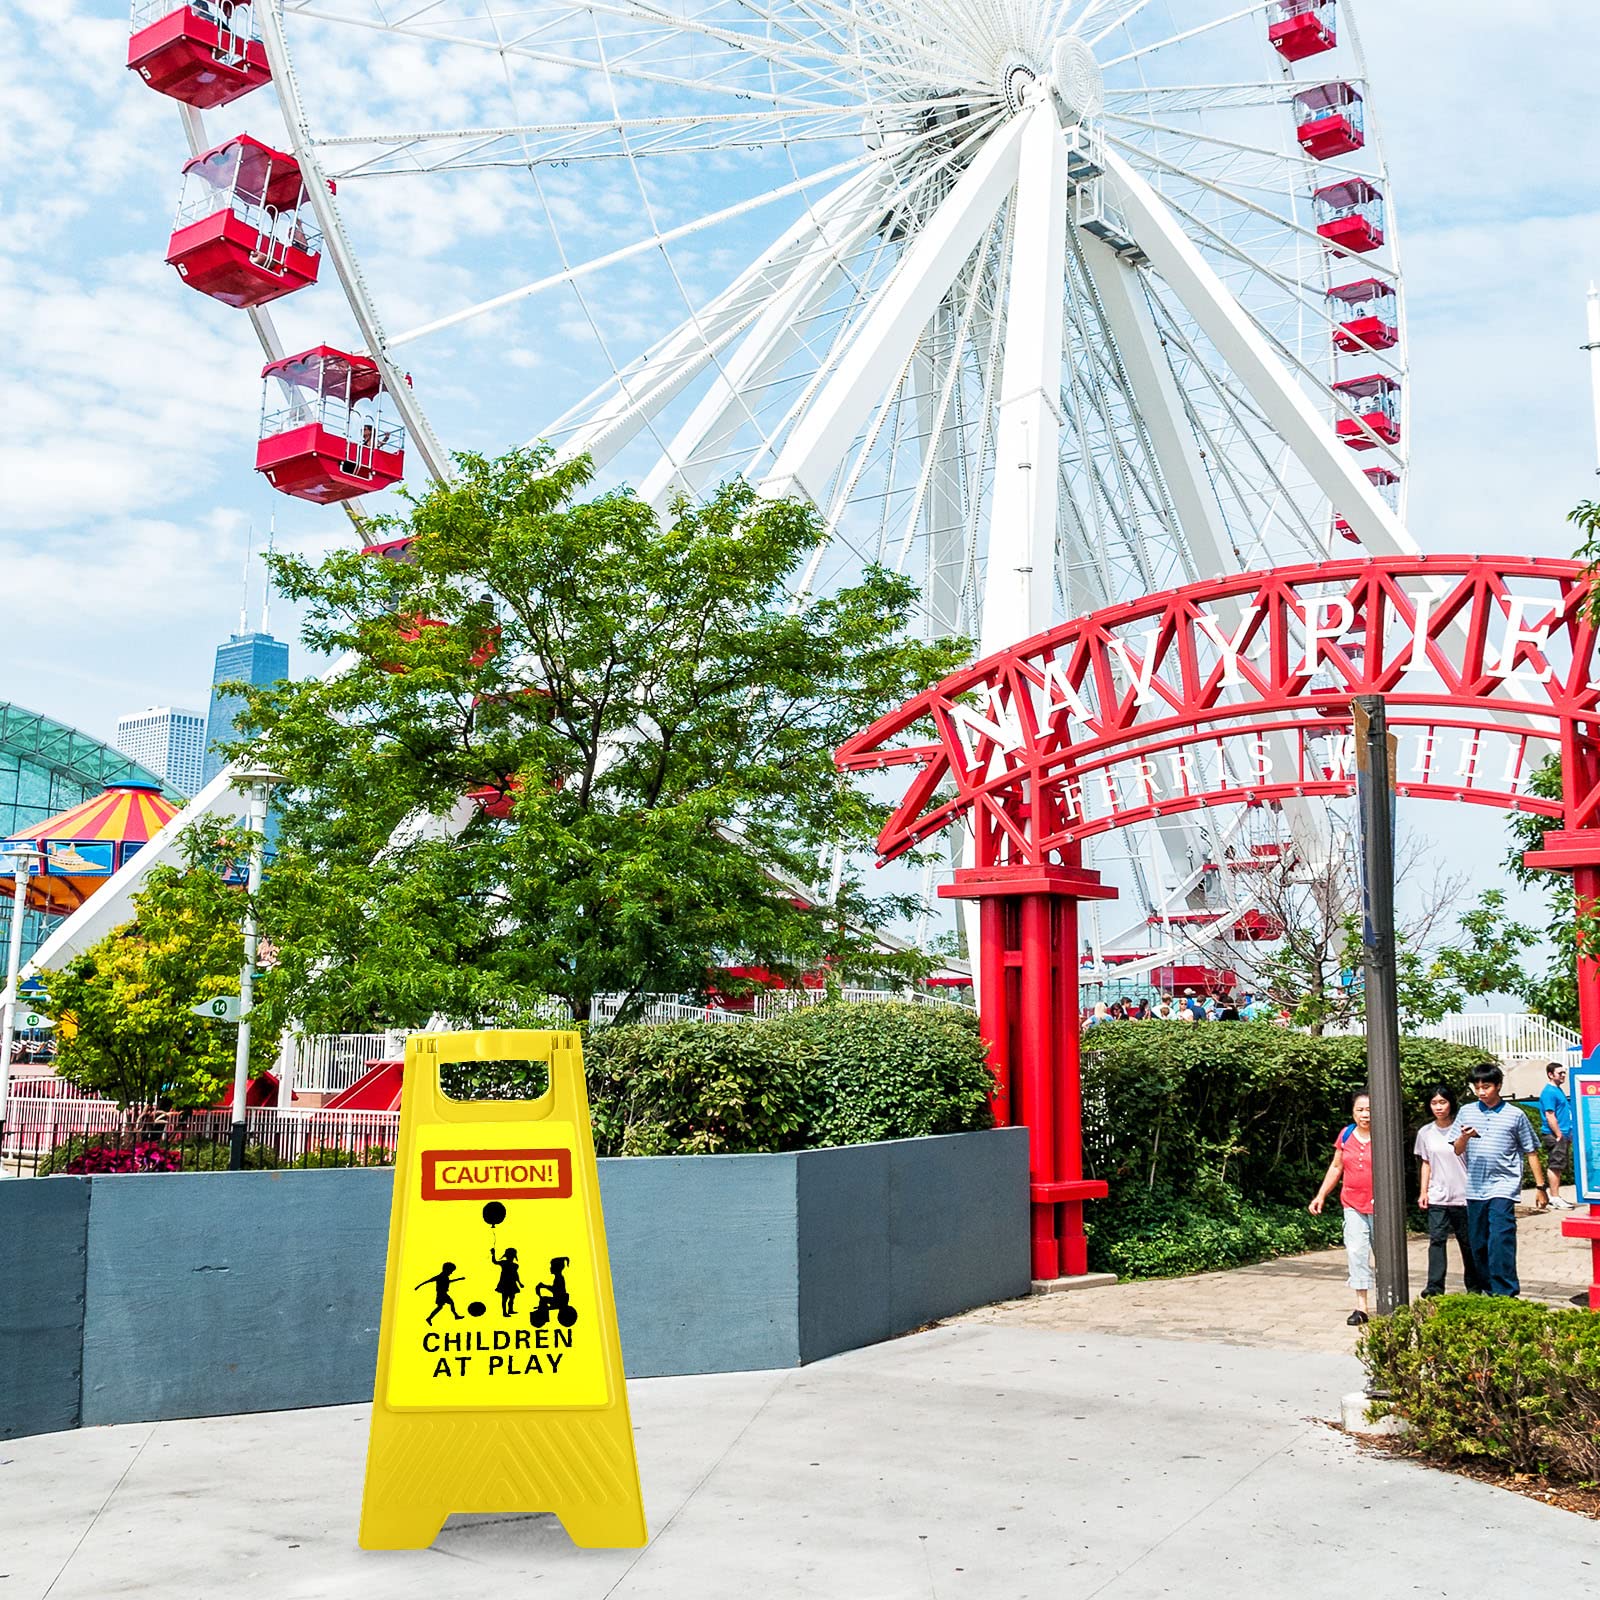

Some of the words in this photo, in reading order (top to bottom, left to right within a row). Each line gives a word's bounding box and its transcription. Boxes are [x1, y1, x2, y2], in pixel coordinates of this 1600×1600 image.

[140, 65, 152, 80] 5
[177, 262, 189, 276] 6
[1060, 738, 1273, 821] FERRIS
[1324, 733, 1529, 785] WEEL
[214, 1002, 226, 1013] 14
[28, 1016, 39, 1025] 13
[442, 1164, 553, 1184] CAUTION!
[422, 1328, 573, 1353] CHILDREN
[432, 1356, 472, 1378] AT
[488, 1353, 563, 1376] PLAY
